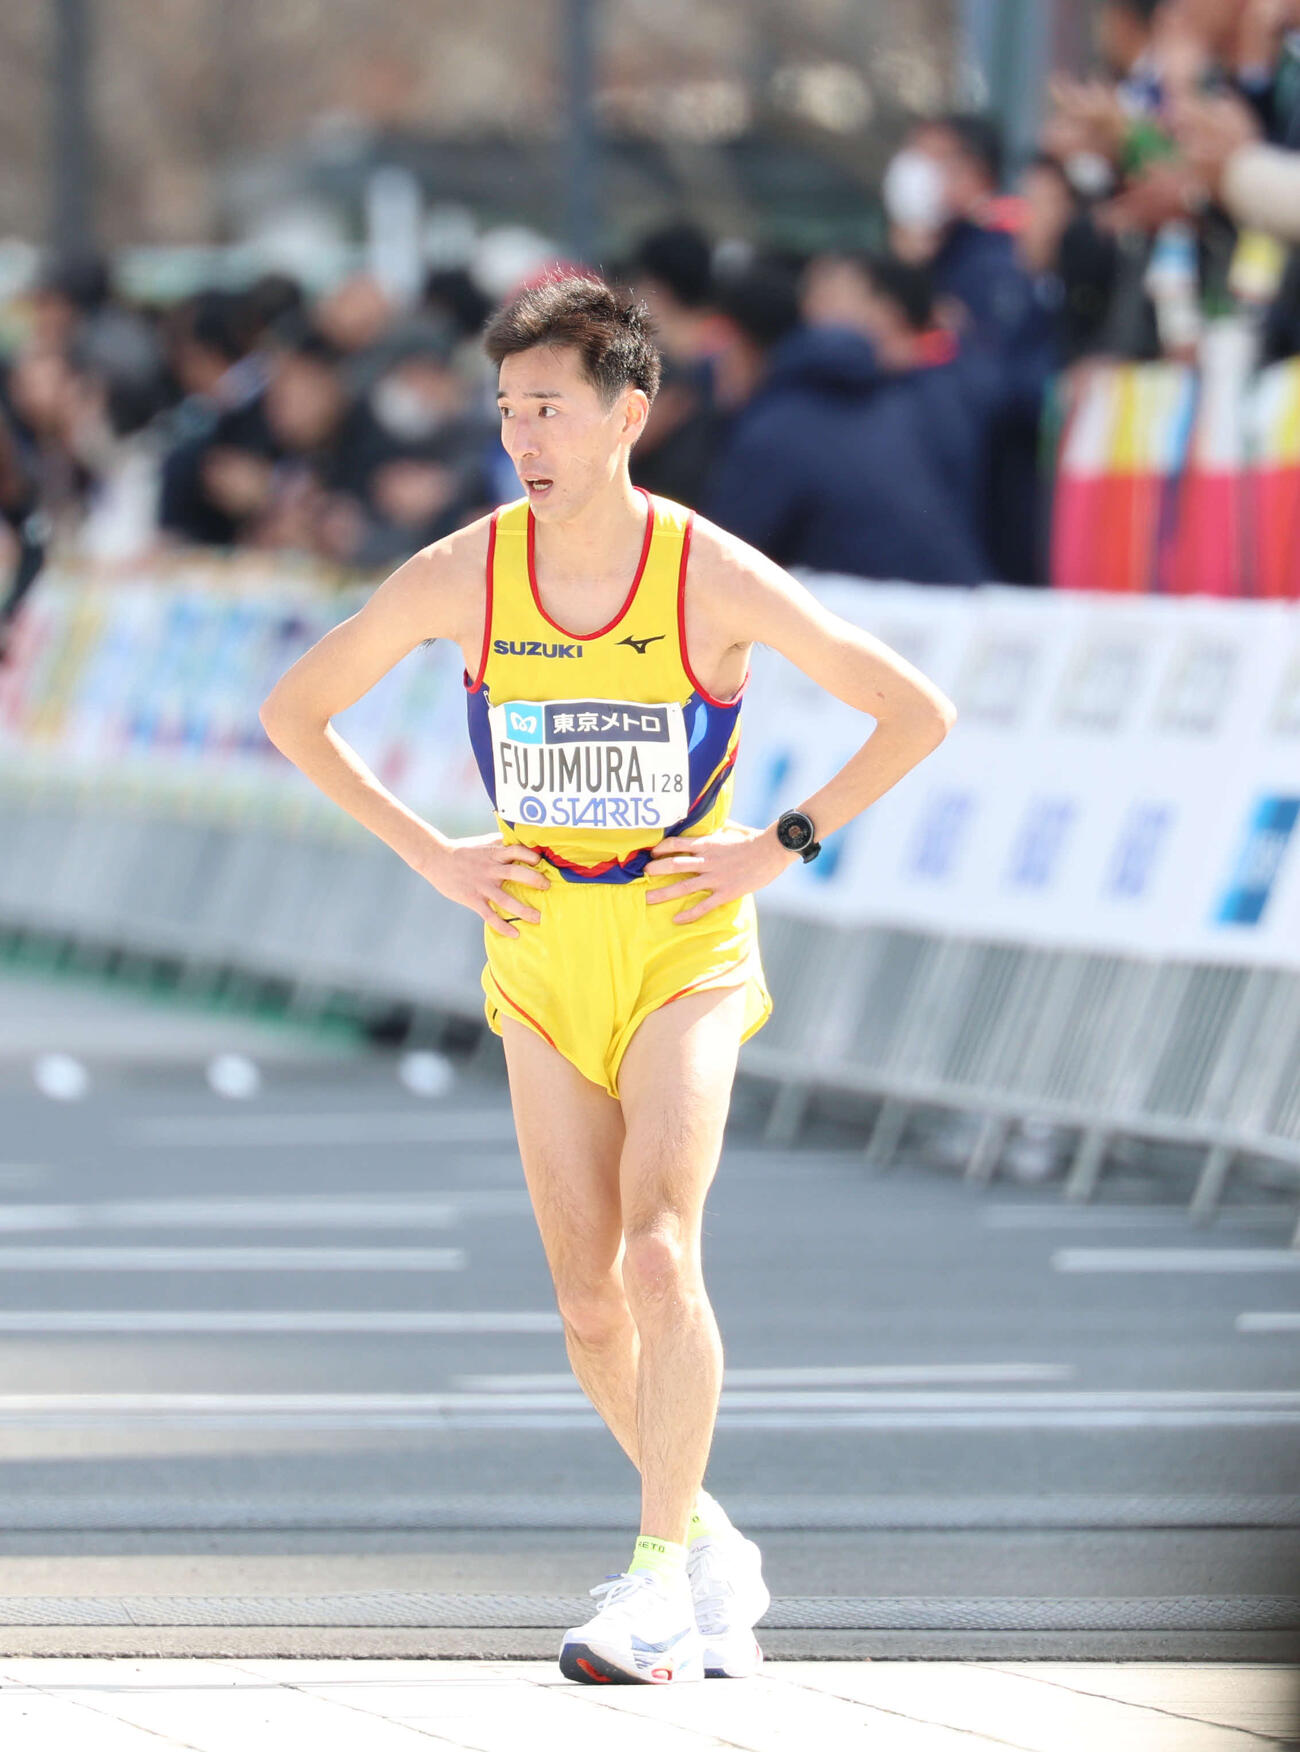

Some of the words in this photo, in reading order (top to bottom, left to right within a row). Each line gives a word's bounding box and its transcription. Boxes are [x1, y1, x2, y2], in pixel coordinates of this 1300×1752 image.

[493, 639, 583, 659] SUZUKI
[552, 711, 662, 734] 東京メトロ
[500, 741, 644, 793] FUJIMURA
[651, 773, 684, 793] 128
